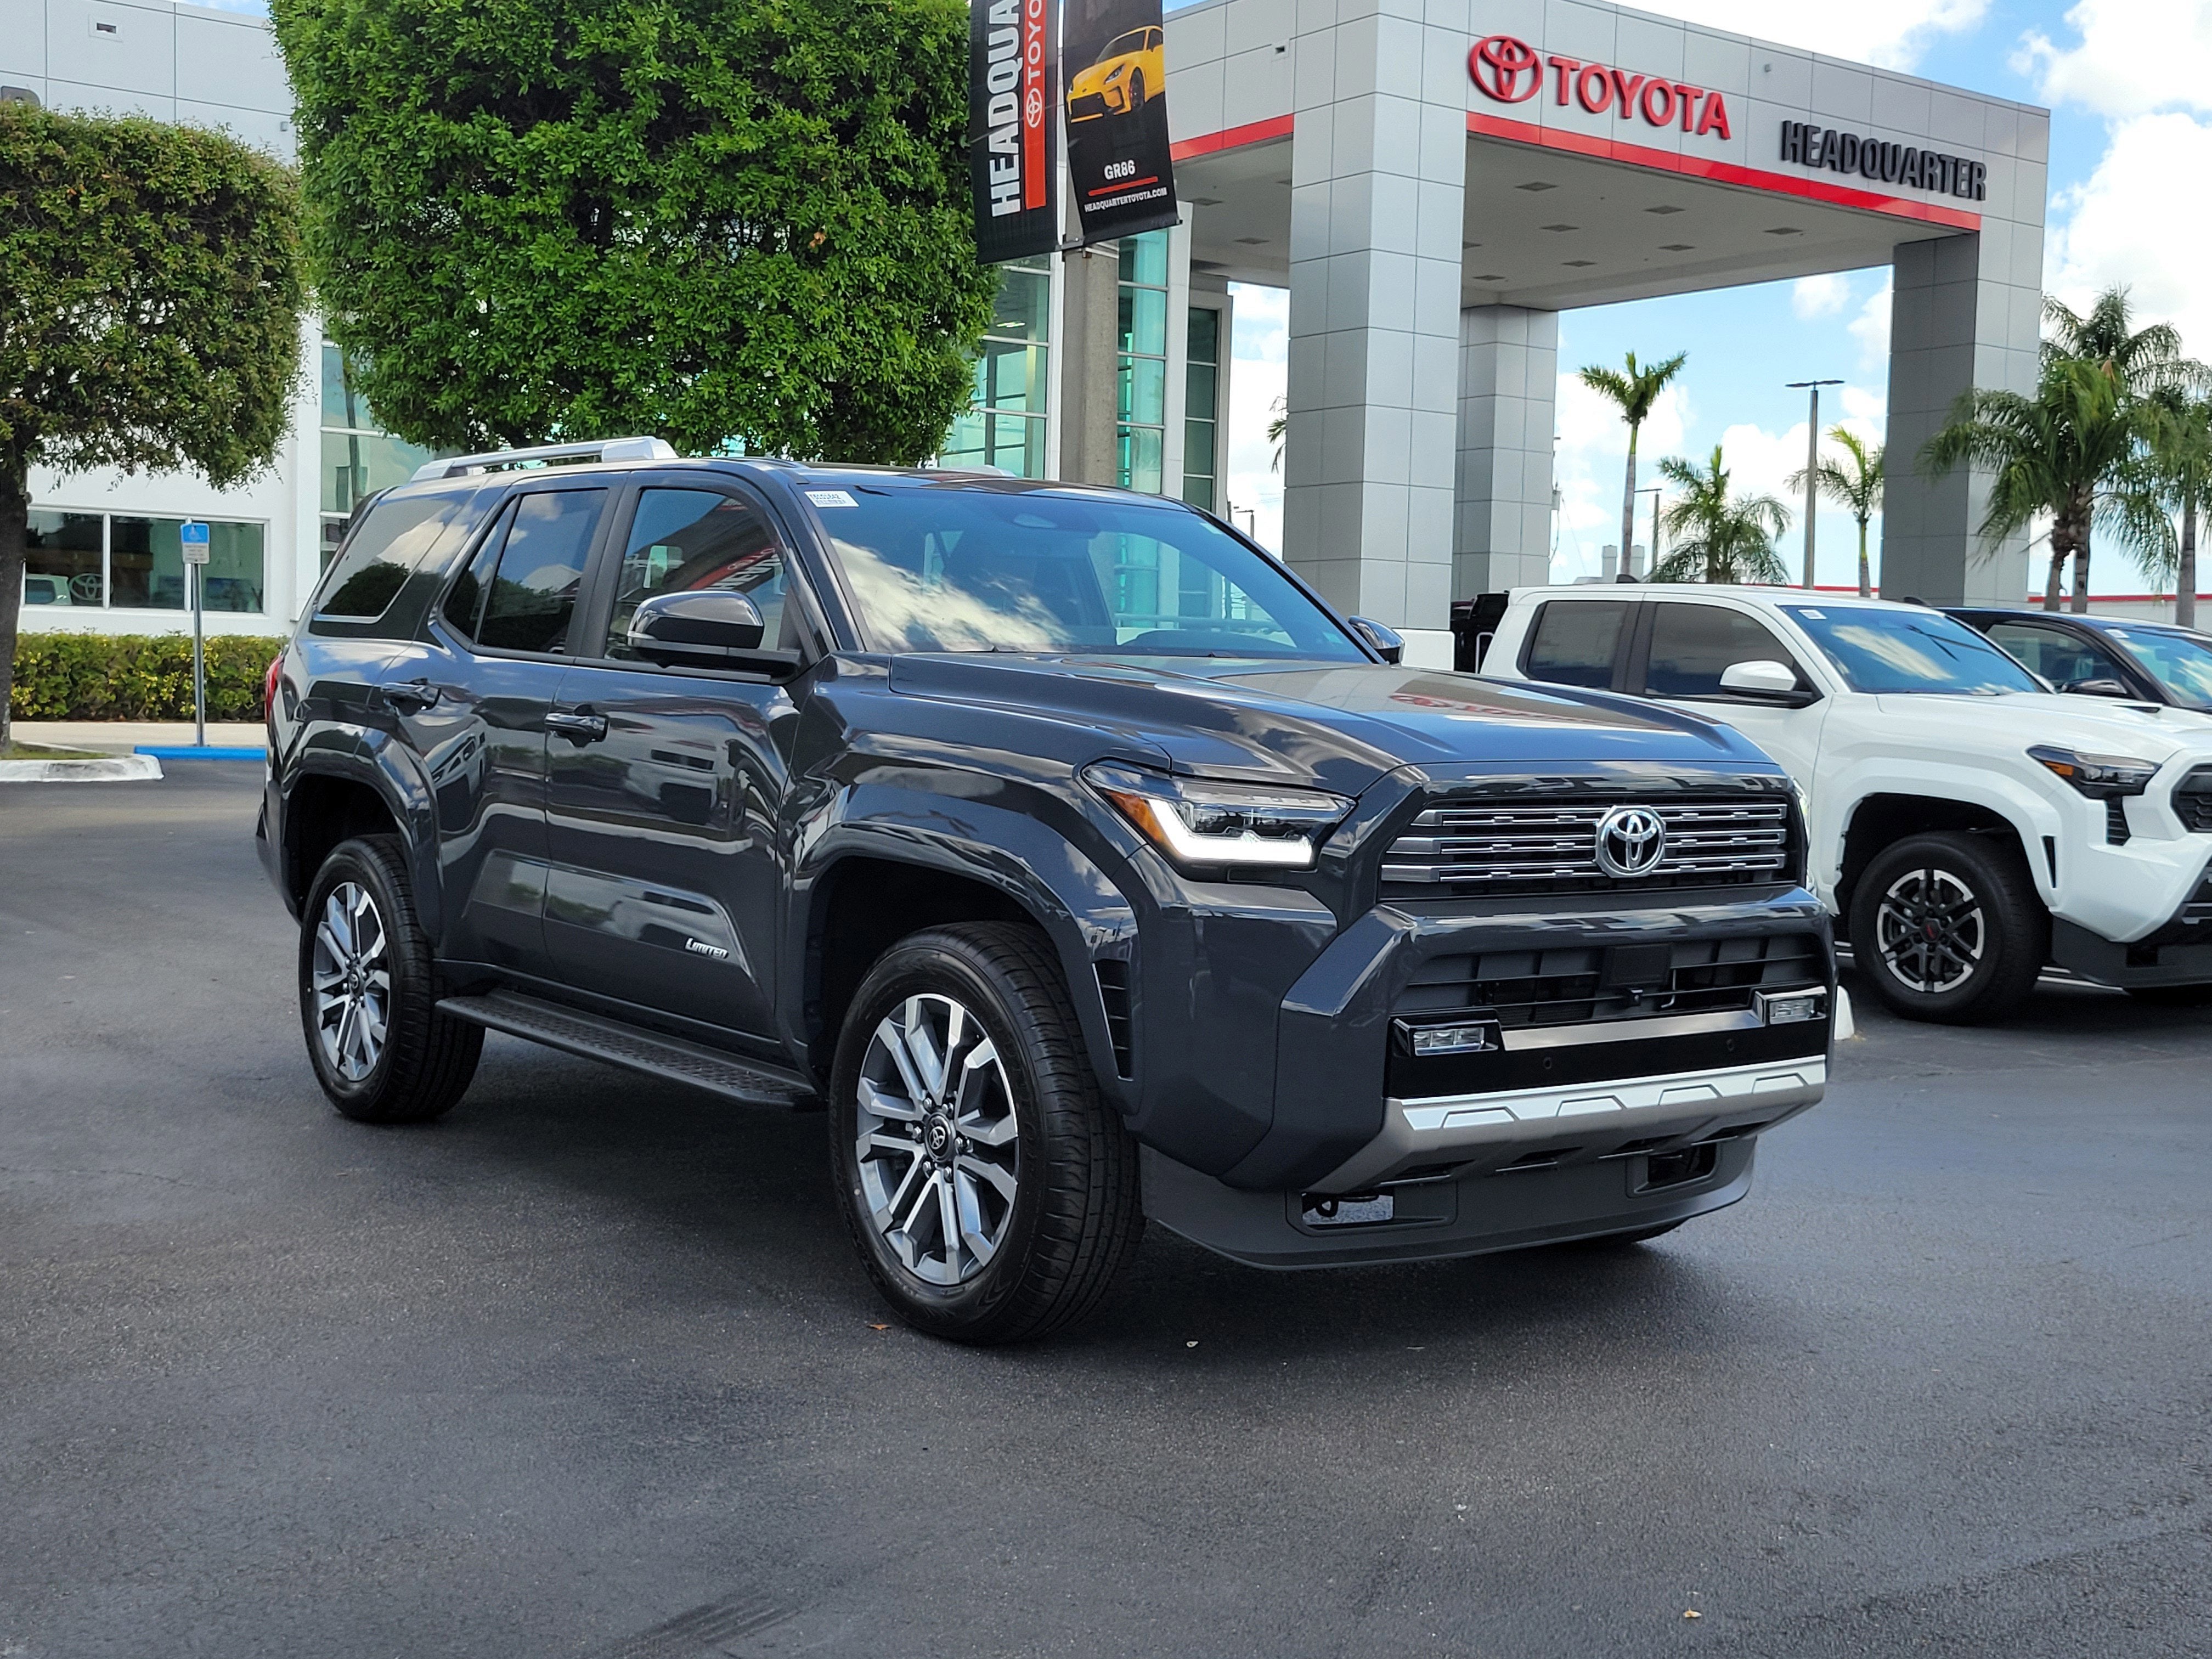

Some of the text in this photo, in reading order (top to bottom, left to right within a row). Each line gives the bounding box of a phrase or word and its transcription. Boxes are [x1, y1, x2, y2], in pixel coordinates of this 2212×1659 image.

[1028, 0, 1042, 86] TOYO
[988, 0, 1023, 217] HEADQUA
[1548, 56, 1731, 140] TOYOTA
[1084, 187, 1167, 213] HEADQUARTERTOYOTA.COM
[1104, 159, 1136, 180] GR86
[1781, 120, 1987, 201] HEADQUARTER
